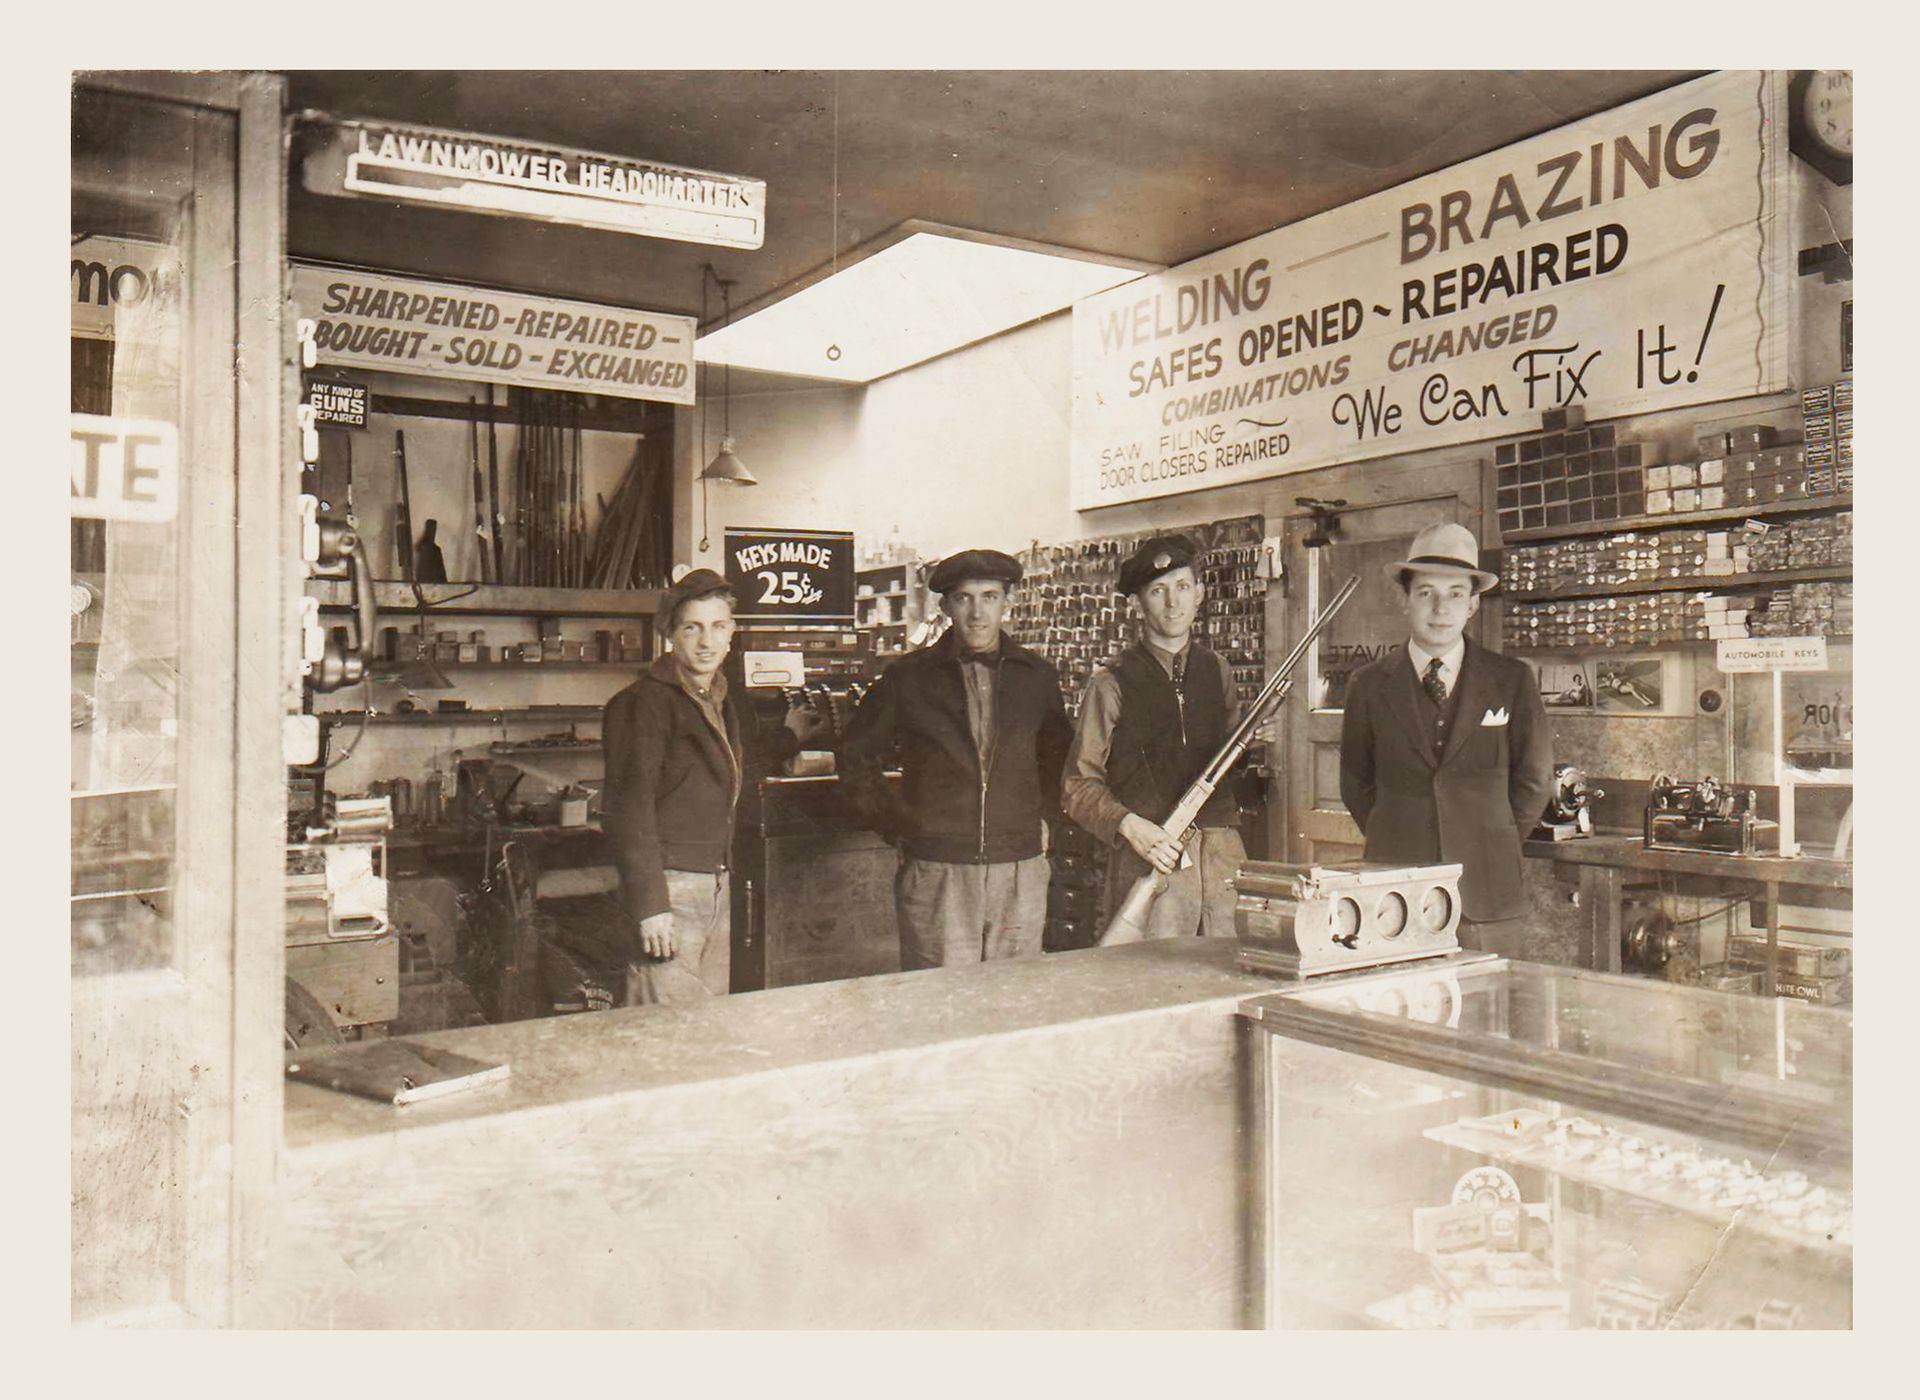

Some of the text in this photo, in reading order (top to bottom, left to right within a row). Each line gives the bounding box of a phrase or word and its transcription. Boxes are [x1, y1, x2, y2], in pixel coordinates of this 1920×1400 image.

[358, 129, 752, 208] LAWNMOWER HEADQUARTERS
[1101, 108, 1720, 355] WELDING BRAZING
[1129, 223, 1629, 398] SAFES OPENED REPAIRED
[313, 320, 688, 389] BOUGHT SOLD EXCHANGED
[1162, 305, 1558, 426] COMBINATIONS CHANGED
[1332, 284, 1725, 441] We Can Fix It!
[310, 393, 365, 414] GUNS
[311, 383, 366, 398] ANY KIND OF
[316, 410, 364, 425] EPAIRED
[1100, 433, 1290, 490] DOOR CLOSERS REPAIRED
[1101, 424, 1226, 467] SAW FILING
[735, 542, 832, 573] KEYS MADE
[1724, 649, 1819, 660] AUTOMOBILE KEYS
[1775, 984, 1821, 999] HITE OWL
